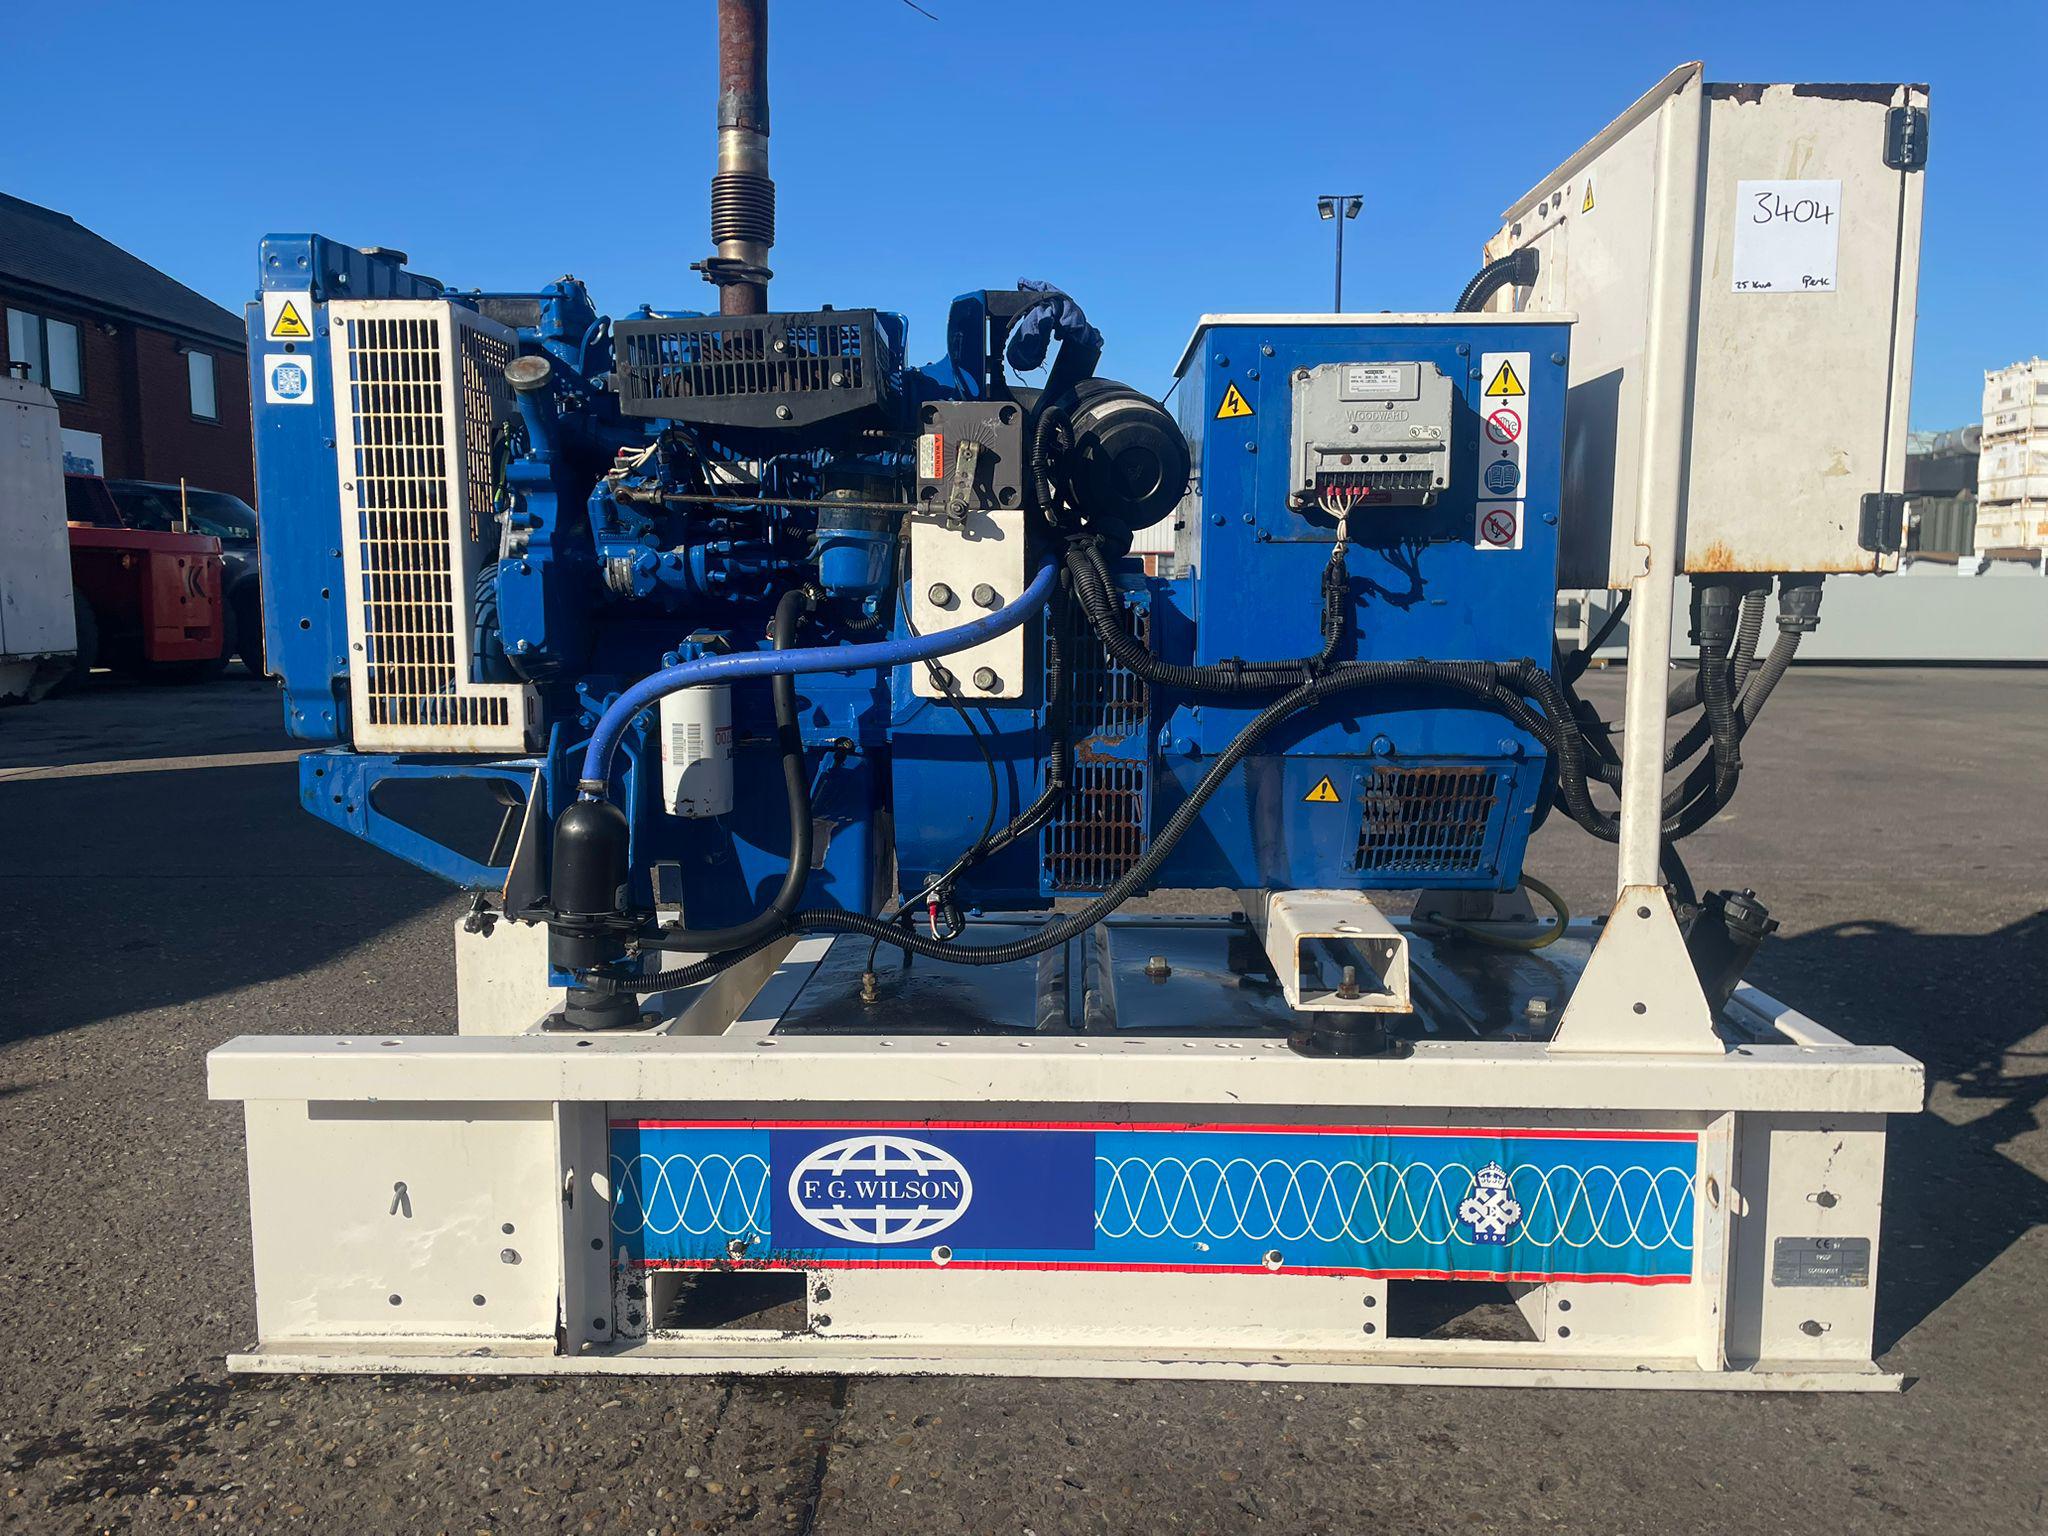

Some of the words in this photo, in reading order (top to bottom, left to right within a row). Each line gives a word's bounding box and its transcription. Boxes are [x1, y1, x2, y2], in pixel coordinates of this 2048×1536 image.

[1753, 192, 1834, 225] 3404
[1735, 281, 1749, 290] 25
[1346, 410, 1409, 422] WOODWARD
[804, 1181, 822, 1199] F.
[827, 1181, 851, 1199] G.
[855, 1181, 960, 1199] WILSON
